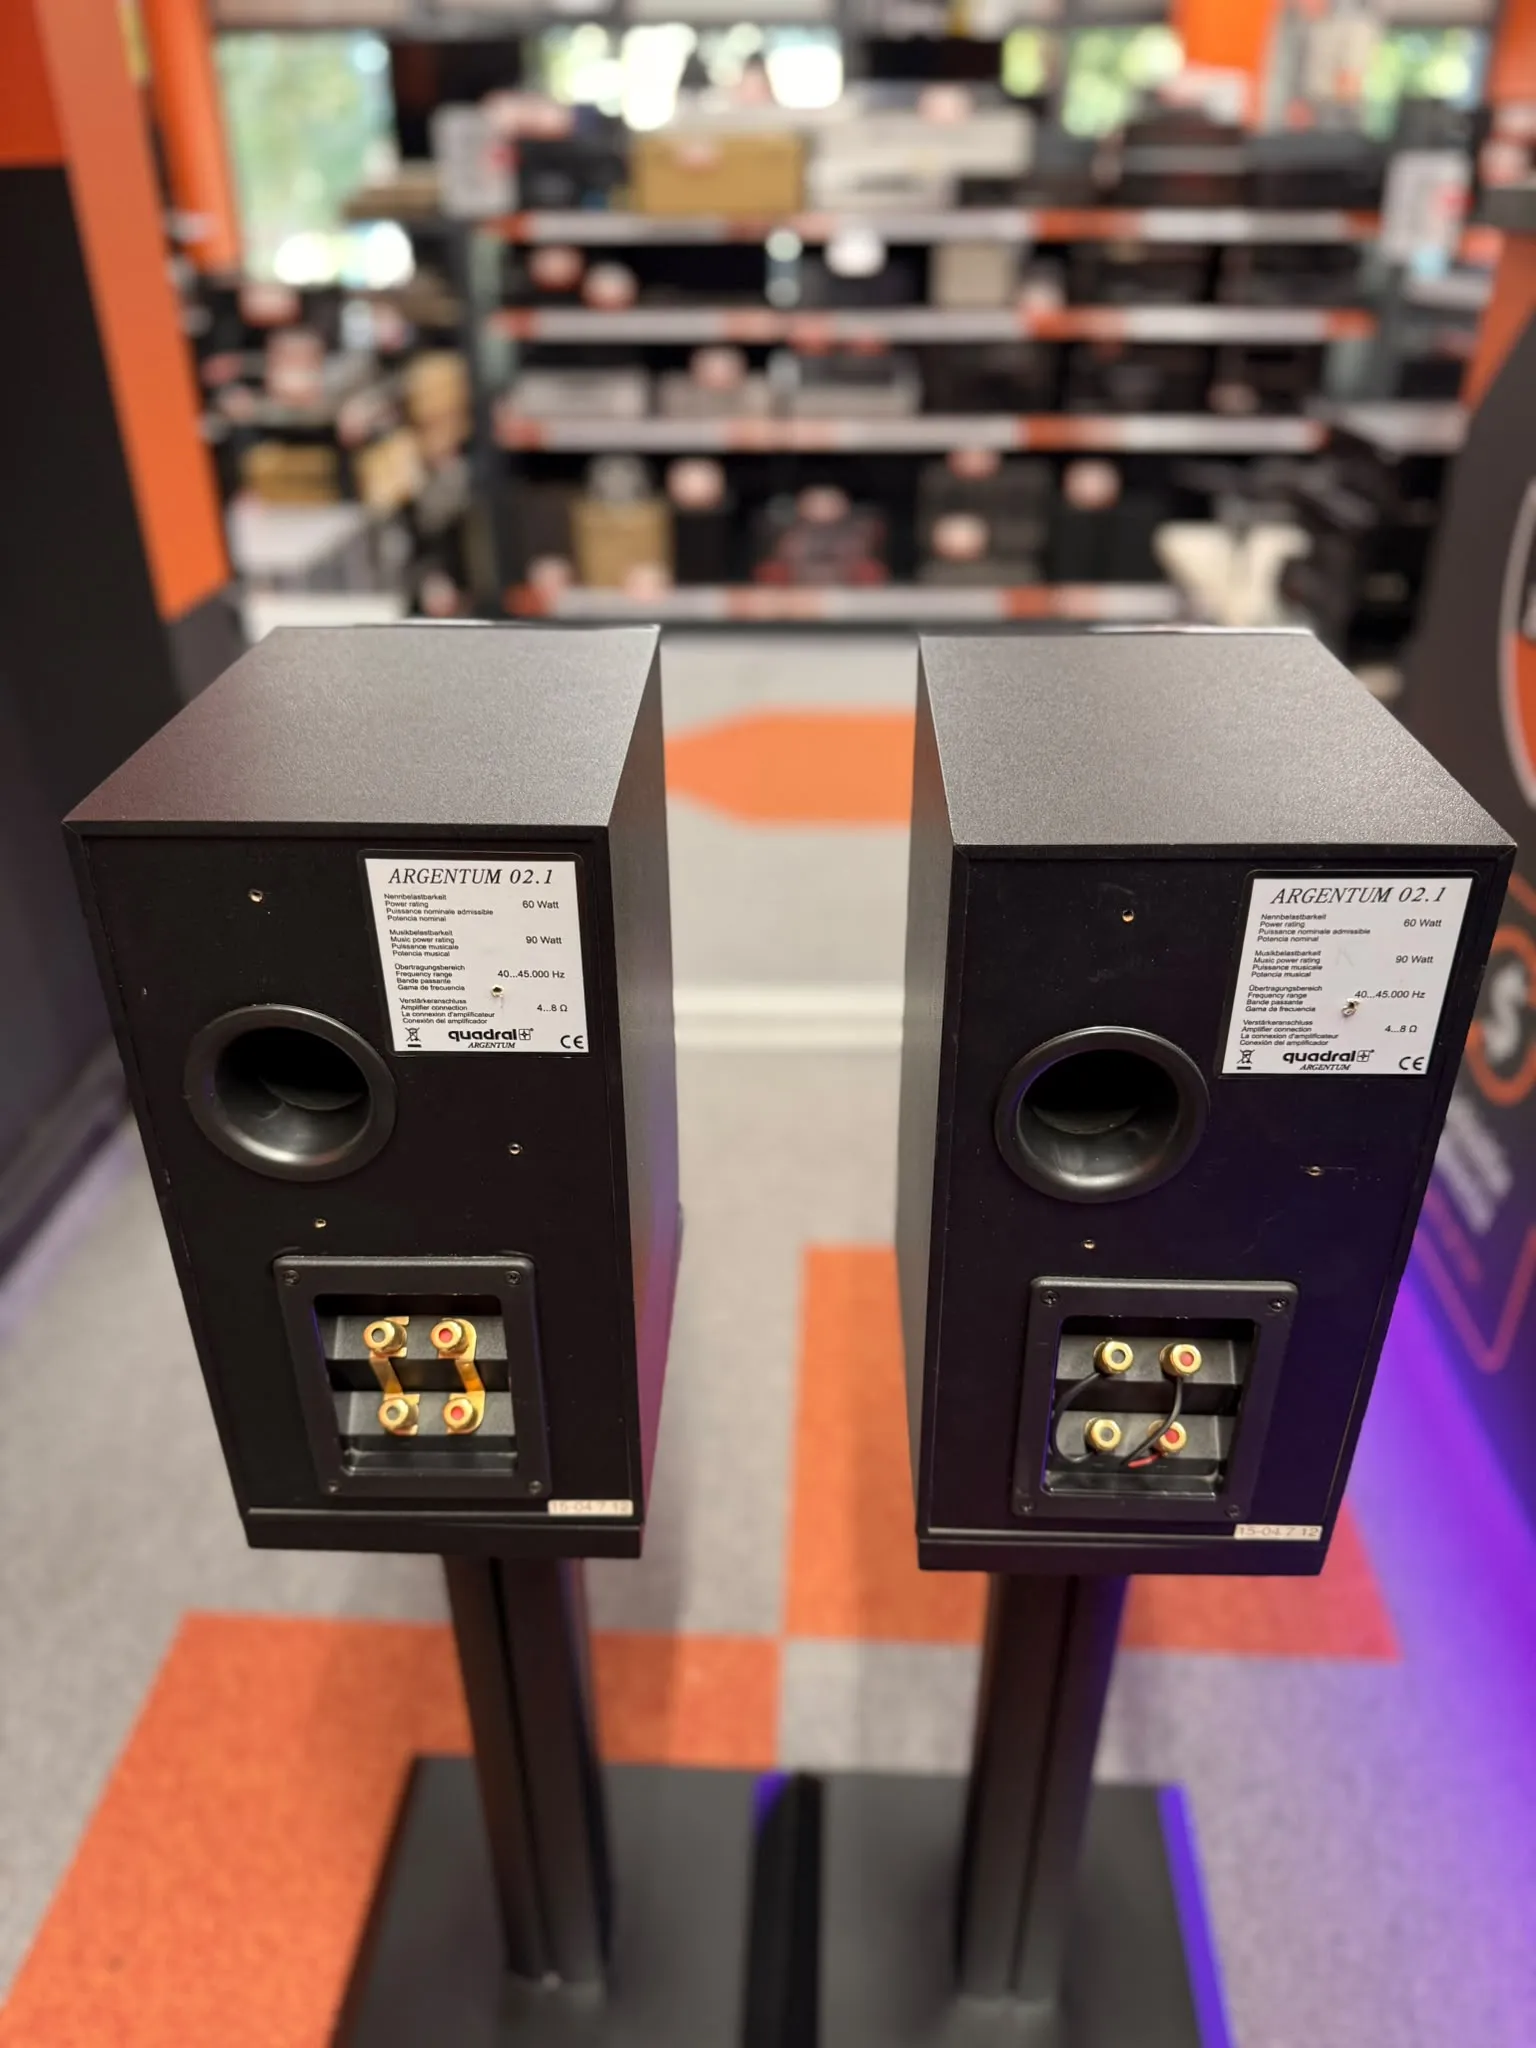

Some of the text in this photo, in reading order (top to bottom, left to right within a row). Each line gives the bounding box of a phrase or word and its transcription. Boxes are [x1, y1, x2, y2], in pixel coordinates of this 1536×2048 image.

[388, 868, 553, 884] ARGENTUM 02.1
[1270, 887, 1446, 904] ARGENTUM 02.1
[537, 901, 559, 909] Watt
[1404, 919, 1441, 927] 60 Watt
[526, 936, 562, 944] 90 Watt
[498, 970, 565, 979] 40...45.000 Hz
[1354, 990, 1410, 998] 40...45.000
[537, 1004, 557, 1012] 4...8
[1385, 1025, 1406, 1033] 4...8
[448, 1029, 517, 1042] quadral
[1283, 1050, 1355, 1063] quadral
